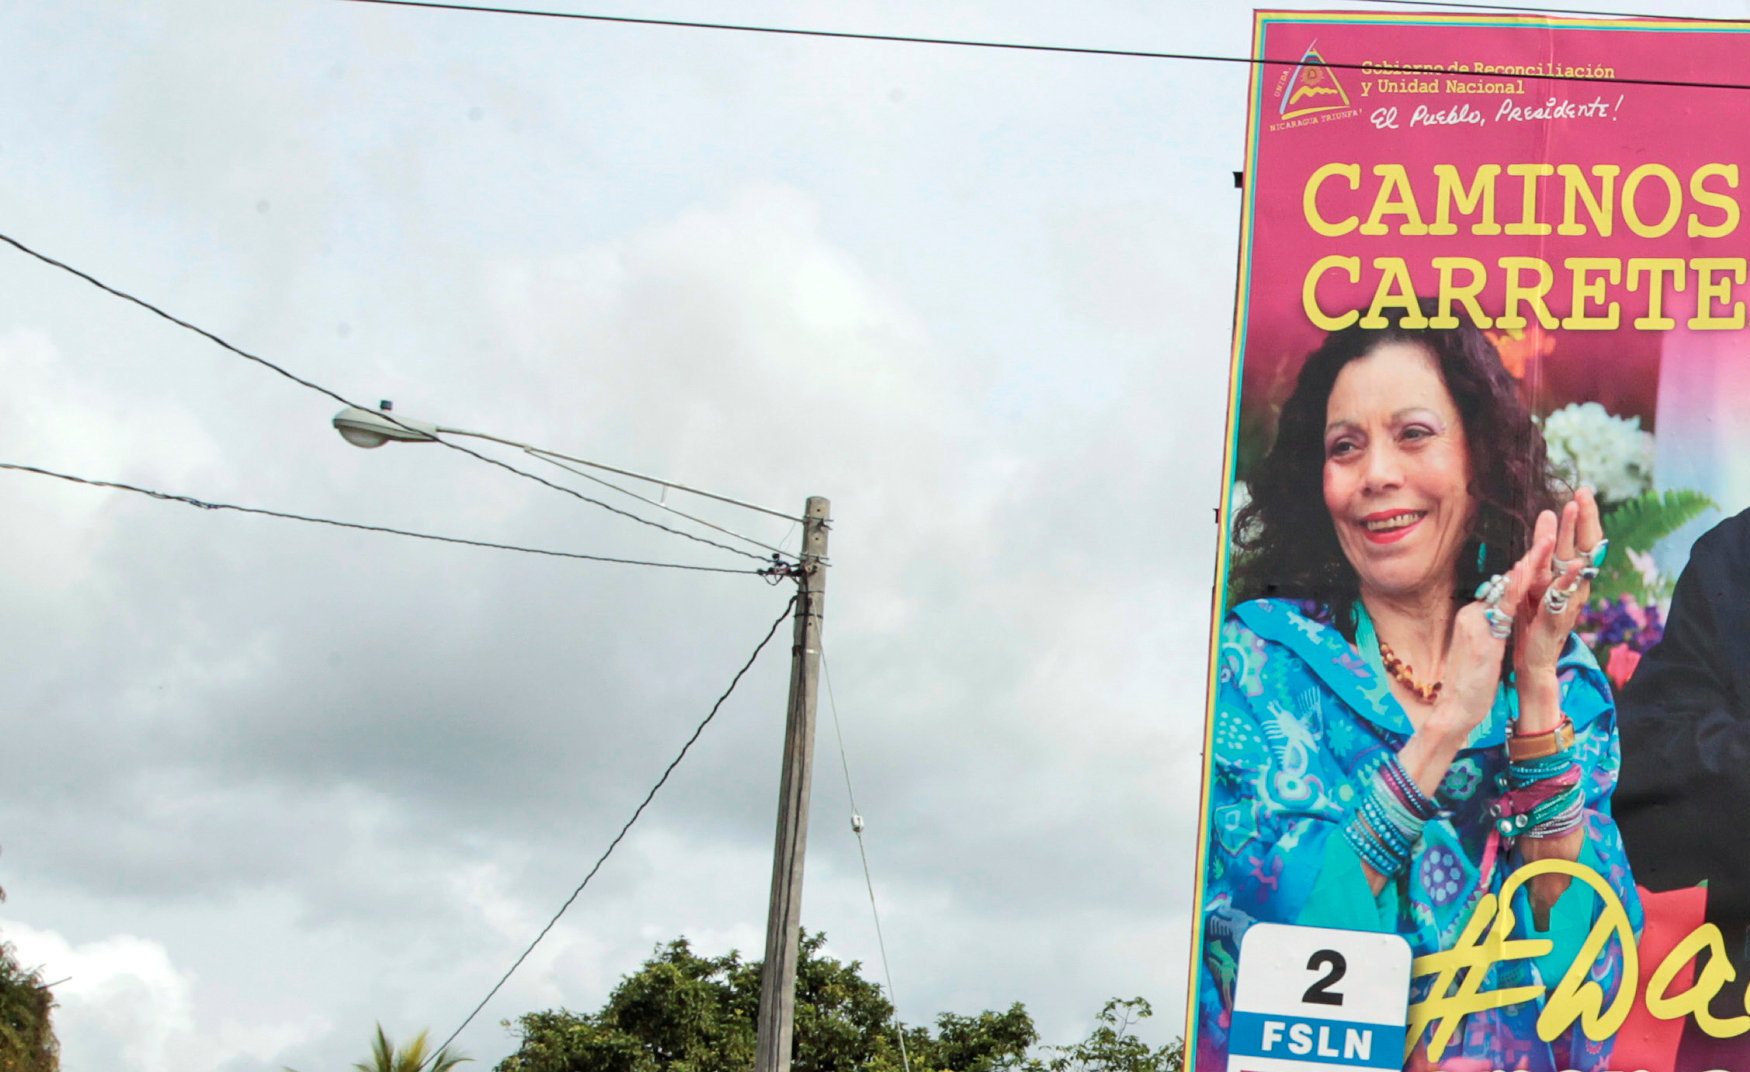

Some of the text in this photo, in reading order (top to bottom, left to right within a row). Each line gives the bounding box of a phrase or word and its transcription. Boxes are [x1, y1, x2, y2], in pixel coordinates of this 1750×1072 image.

[1361, 61, 1615, 79] Gobierno de Reconciliación
[1361, 80, 1525, 97] y Unidad Nacional
[1269, 117, 1319, 132] NICARAGUA
[1370, 95, 1624, 129] El Pueblo, Presidente!
[1303, 162, 1741, 238] CAMINOS
[1302, 948, 1347, 1006] 2
[1261, 1020, 1373, 1061] FSLN
